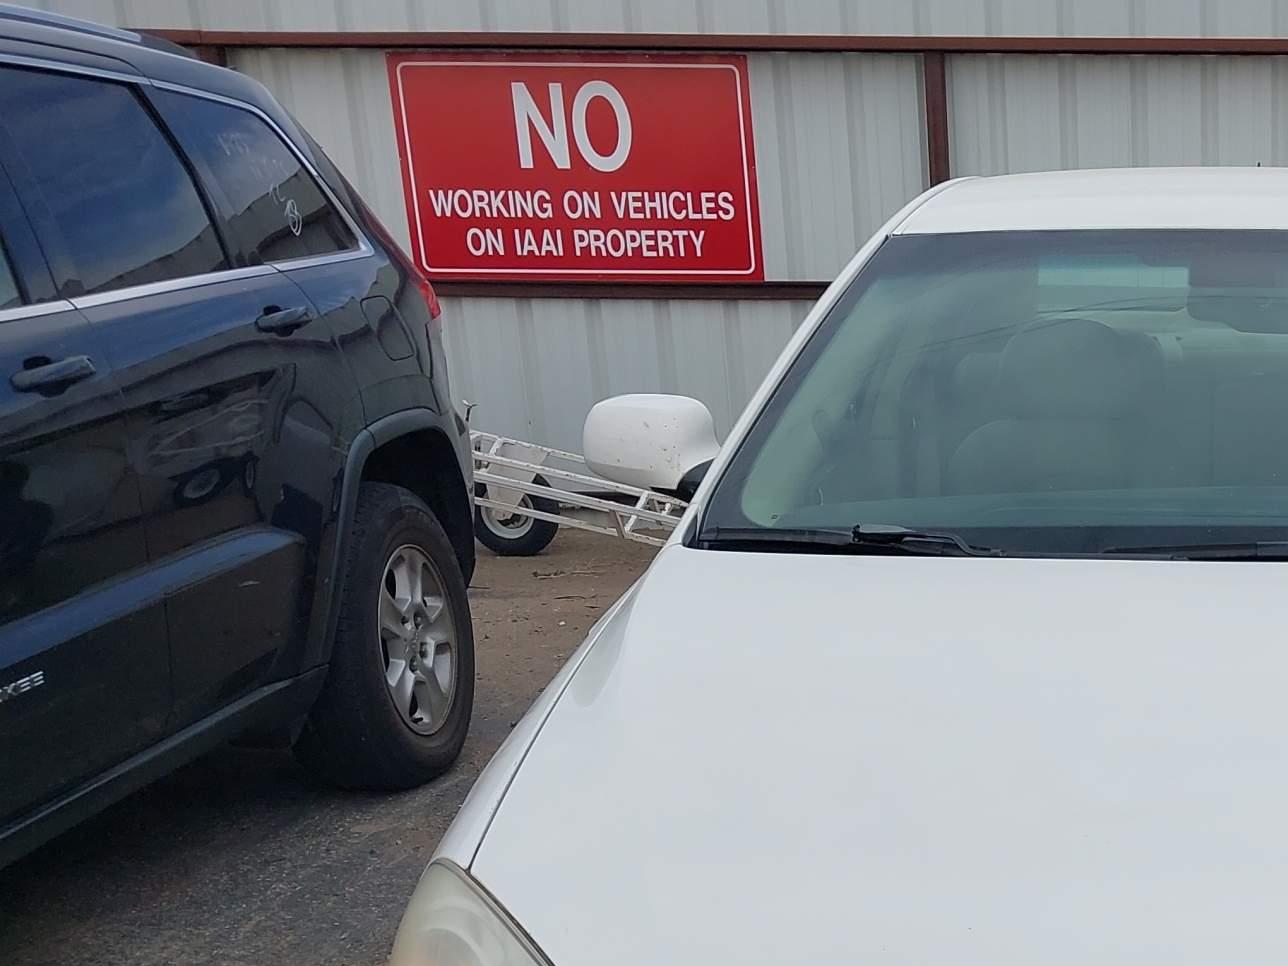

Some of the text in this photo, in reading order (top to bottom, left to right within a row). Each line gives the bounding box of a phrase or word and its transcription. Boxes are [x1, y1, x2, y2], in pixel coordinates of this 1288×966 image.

[510, 80, 633, 173] NO
[428, 189, 735, 221] WORKING ON VEHICLES
[465, 227, 706, 258] ON IAAI PROPERTY
